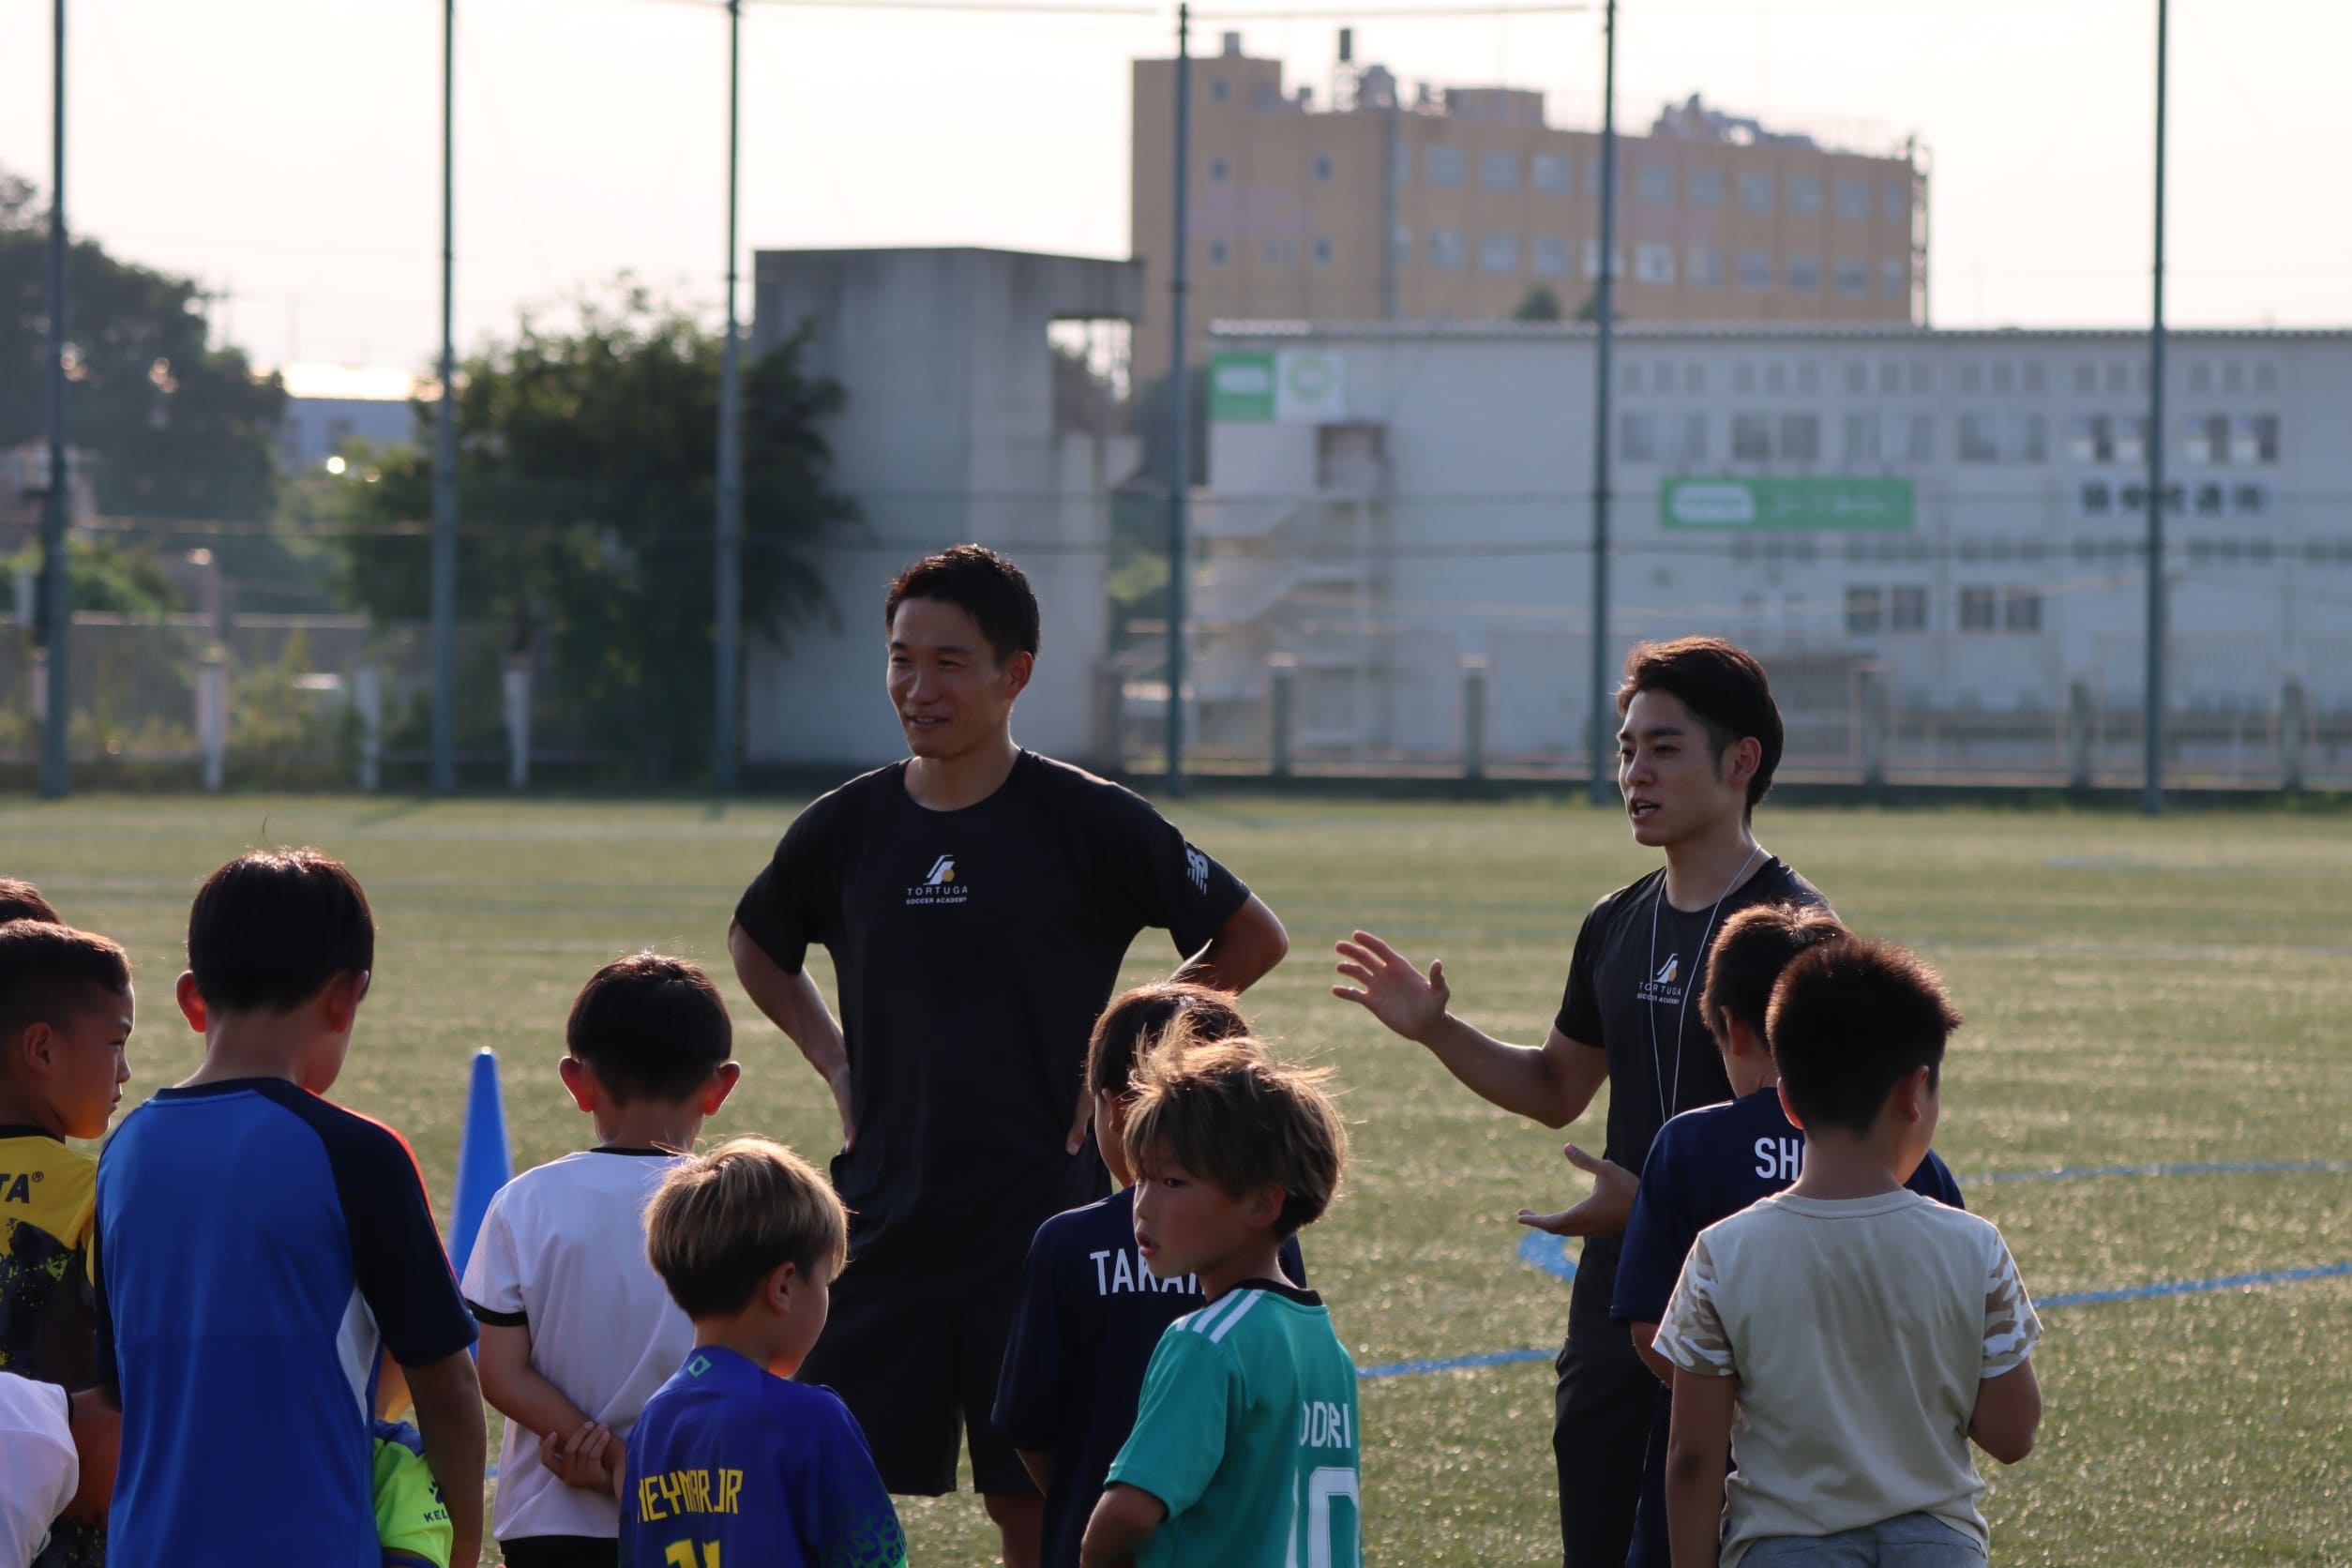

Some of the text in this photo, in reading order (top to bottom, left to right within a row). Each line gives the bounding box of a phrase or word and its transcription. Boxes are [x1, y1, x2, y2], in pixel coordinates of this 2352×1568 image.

[907, 885, 968, 897] TORTUGA
[1638, 981, 1681, 996] TORTUGA
[1755, 1137, 1804, 1181] SH
[424, 1508, 448, 1522] KEL
